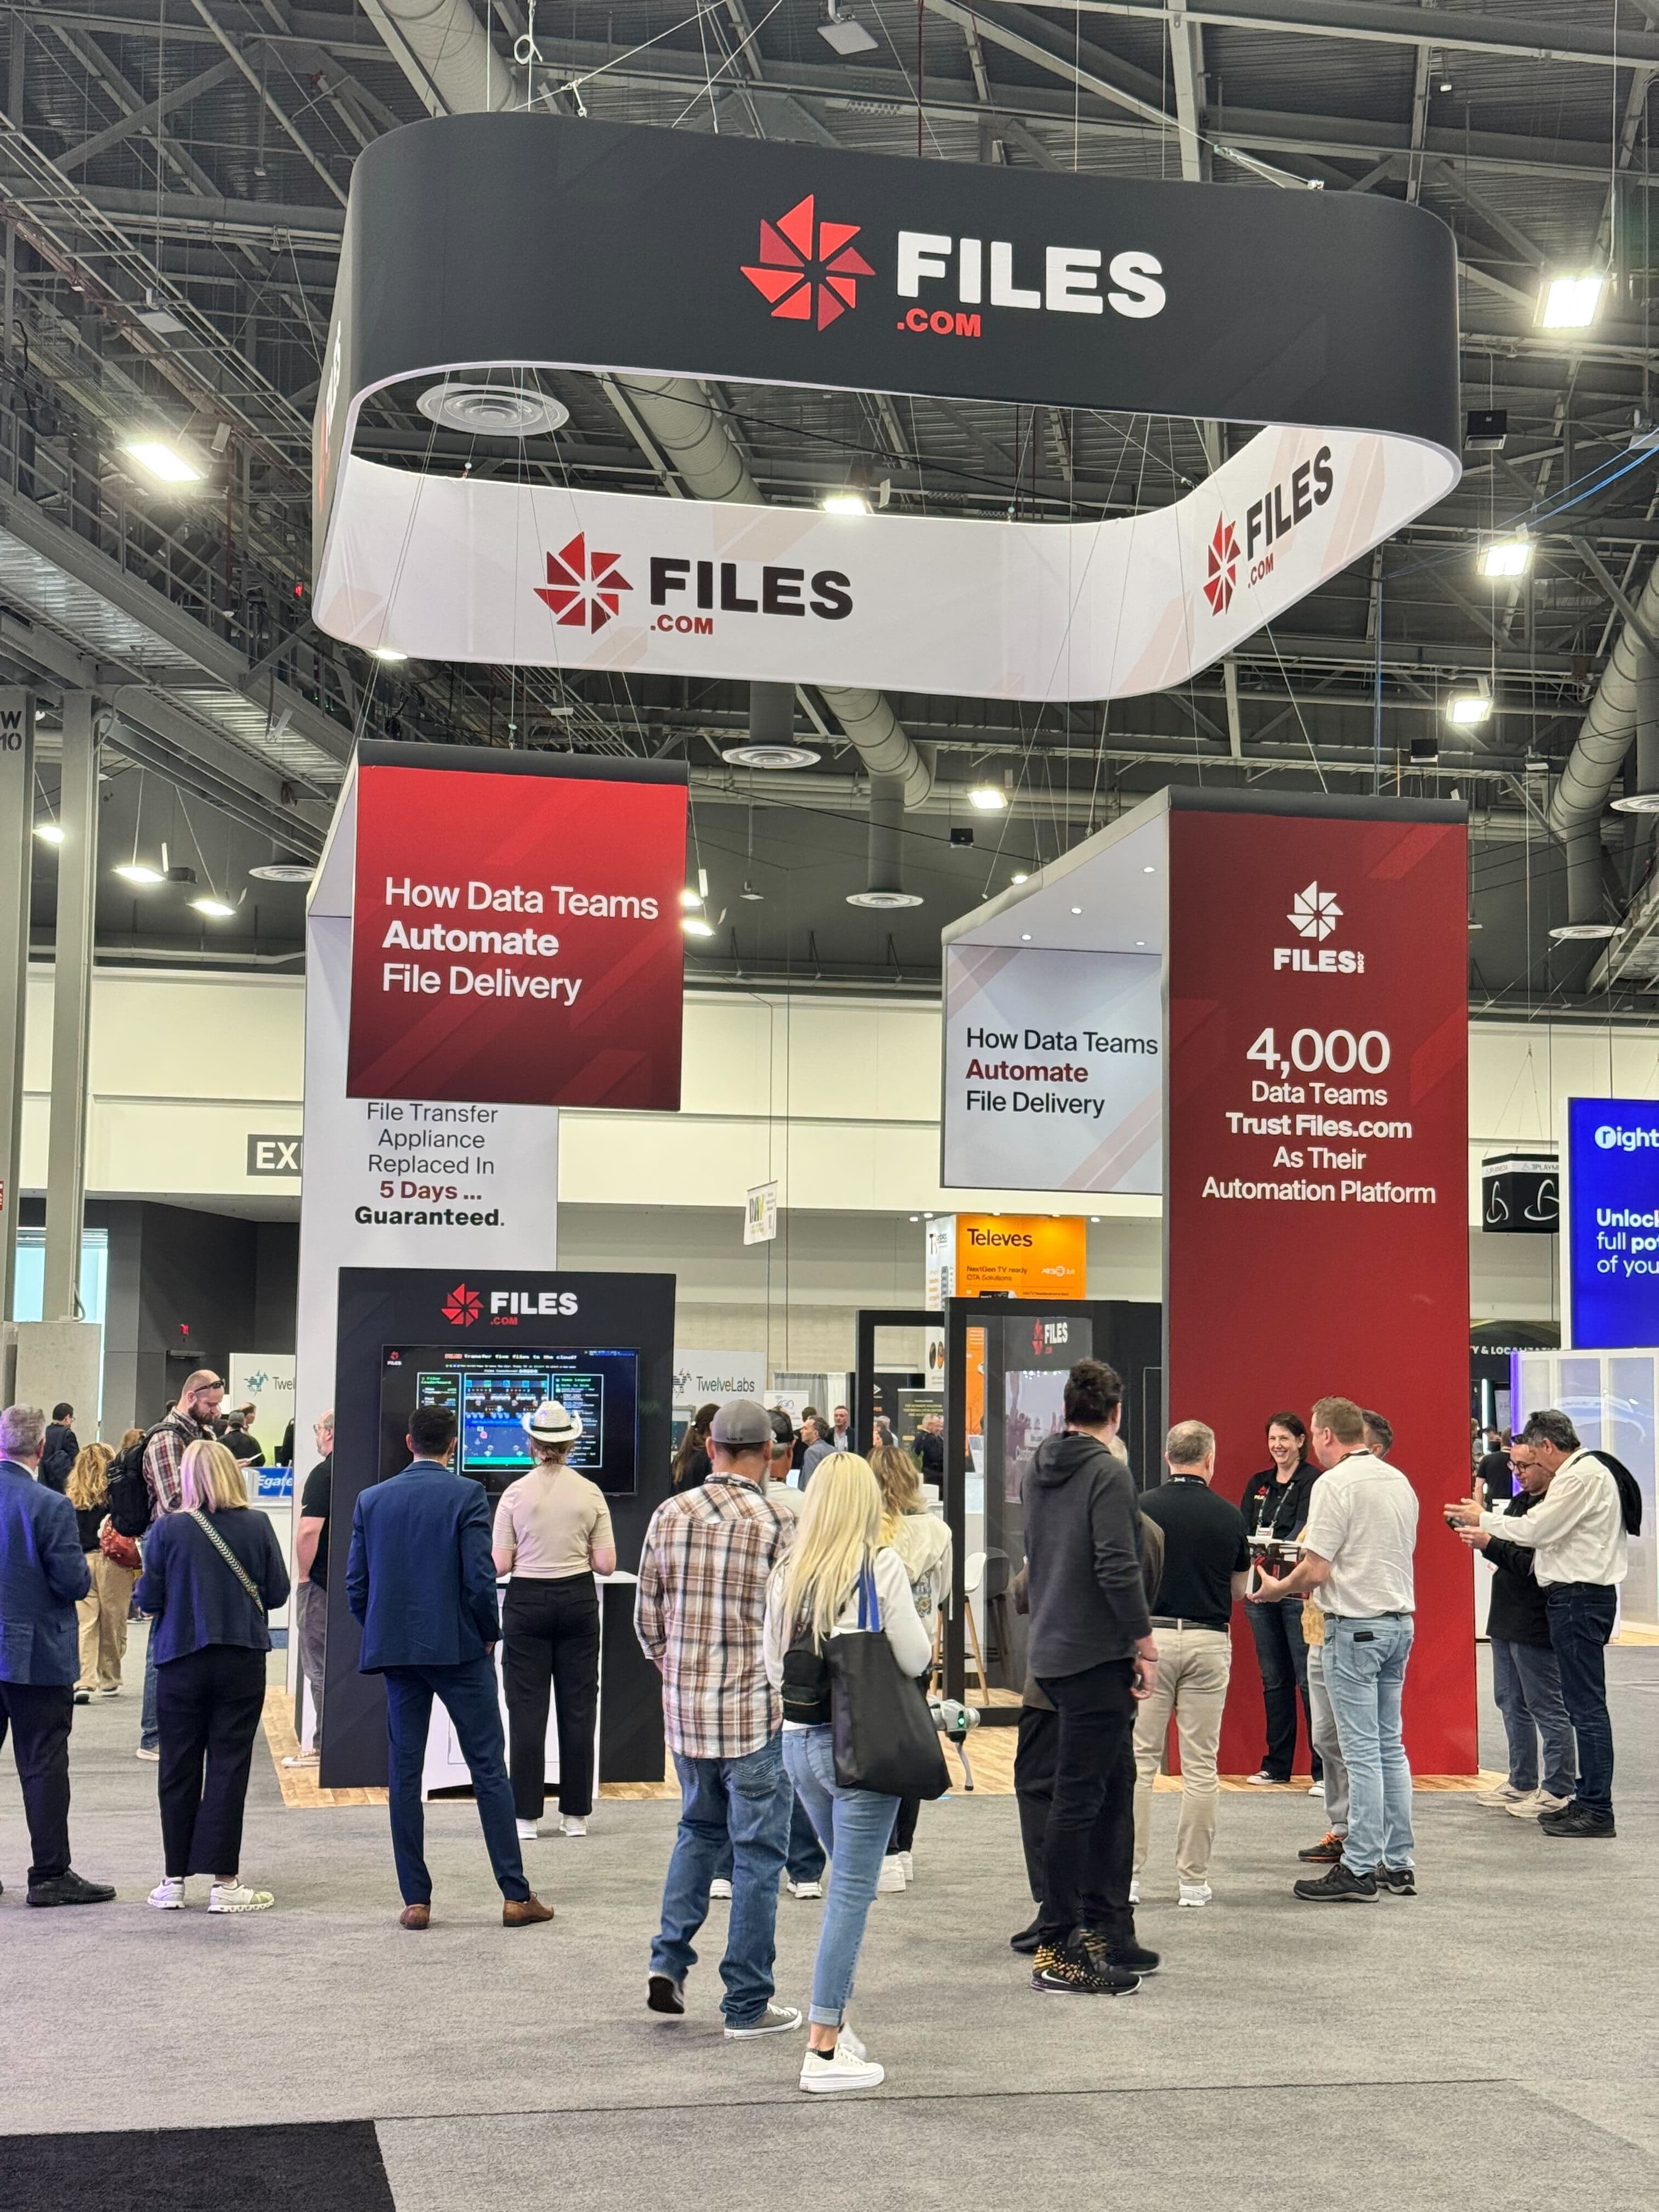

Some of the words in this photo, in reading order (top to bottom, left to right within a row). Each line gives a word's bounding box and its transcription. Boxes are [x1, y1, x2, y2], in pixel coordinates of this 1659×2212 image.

[897, 230, 1166, 319] FILES
[897, 308, 981, 337] .COM
[1246, 445, 1333, 562] FILES
[1248, 552, 1274, 589] .COM
[650, 556, 853, 620] FILES
[650, 614, 713, 635] .COM
[385, 877, 460, 909] How
[467, 881, 544, 913] Data
[551, 885, 658, 920] Teams
[382, 920, 560, 956] Automate
[1273, 948, 1357, 974] FILES
[382, 963, 441, 994] File
[449, 966, 583, 1006] Delivery
[966, 1027, 1018, 1049] How
[1024, 1029, 1077, 1051] Data
[1082, 1031, 1158, 1054] Teams
[1246, 1027, 1391, 1079] 4,000
[965, 1059, 1089, 1083] Automate
[966, 1090, 1007, 1112] File
[1013, 1091, 1105, 1119] Delivery
[1251, 1080, 1305, 1104] Data
[1309, 1082, 1388, 1106] Teams
[367, 1102, 404, 1121] File
[409, 1103, 499, 1124] Transfer
[1225, 1112, 1291, 1136] Trust
[1295, 1114, 1413, 1139] Files.com
[377, 1128, 486, 1151] Appliance
[256, 1141, 303, 1170] EX
[368, 1154, 469, 1177] Replaced
[476, 1156, 494, 1175] In
[1272, 1146, 1304, 1168] As
[1307, 1147, 1367, 1170] Their
[380, 1181, 394, 1199] 5
[400, 1181, 458, 1203] Days
[1201, 1176, 1335, 1201] Automation
[1341, 1180, 1436, 1204] Platform
[354, 1205, 505, 1227] Guaranteed.
[967, 1228, 1032, 1248] Televes
[1596, 1231, 1626, 1250] full
[967, 1265, 996, 1274] NextGen
[1596, 1255, 1618, 1274] of
[490, 1291, 578, 1316] FILES
[490, 1317, 518, 1325] .COM
[1044, 1322, 1068, 1345] FILES
[1481, 1346, 1489, 1355] &
[696, 1376, 755, 1392] TwelveLabs
